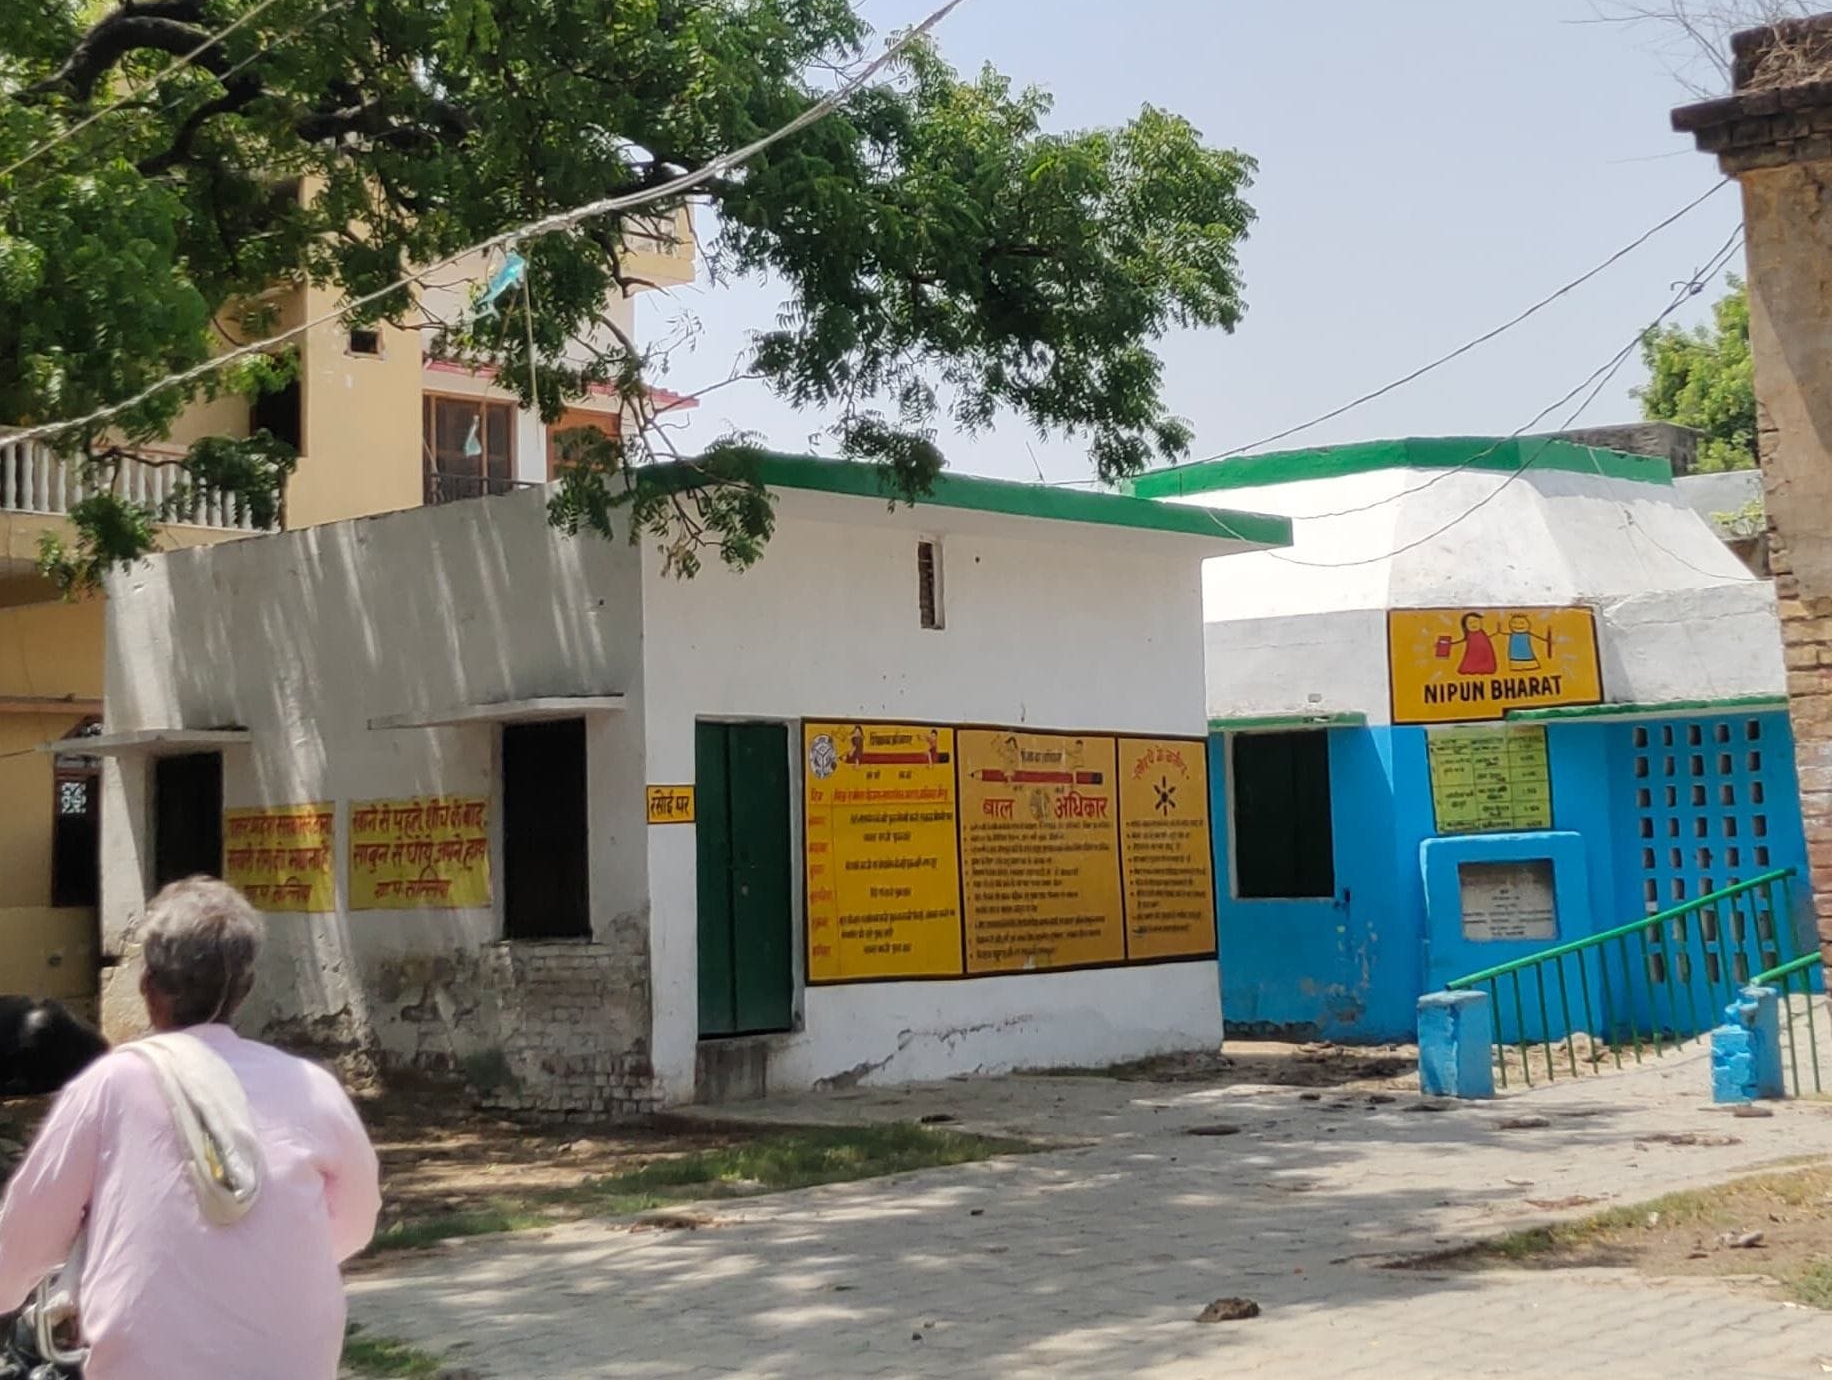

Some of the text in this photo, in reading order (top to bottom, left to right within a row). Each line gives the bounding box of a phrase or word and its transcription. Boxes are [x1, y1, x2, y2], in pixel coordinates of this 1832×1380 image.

[1424, 675, 1562, 704] NIPUN BHARAT
[982, 797, 1015, 819] बाल
[1054, 790, 1109, 819] अधिकार
